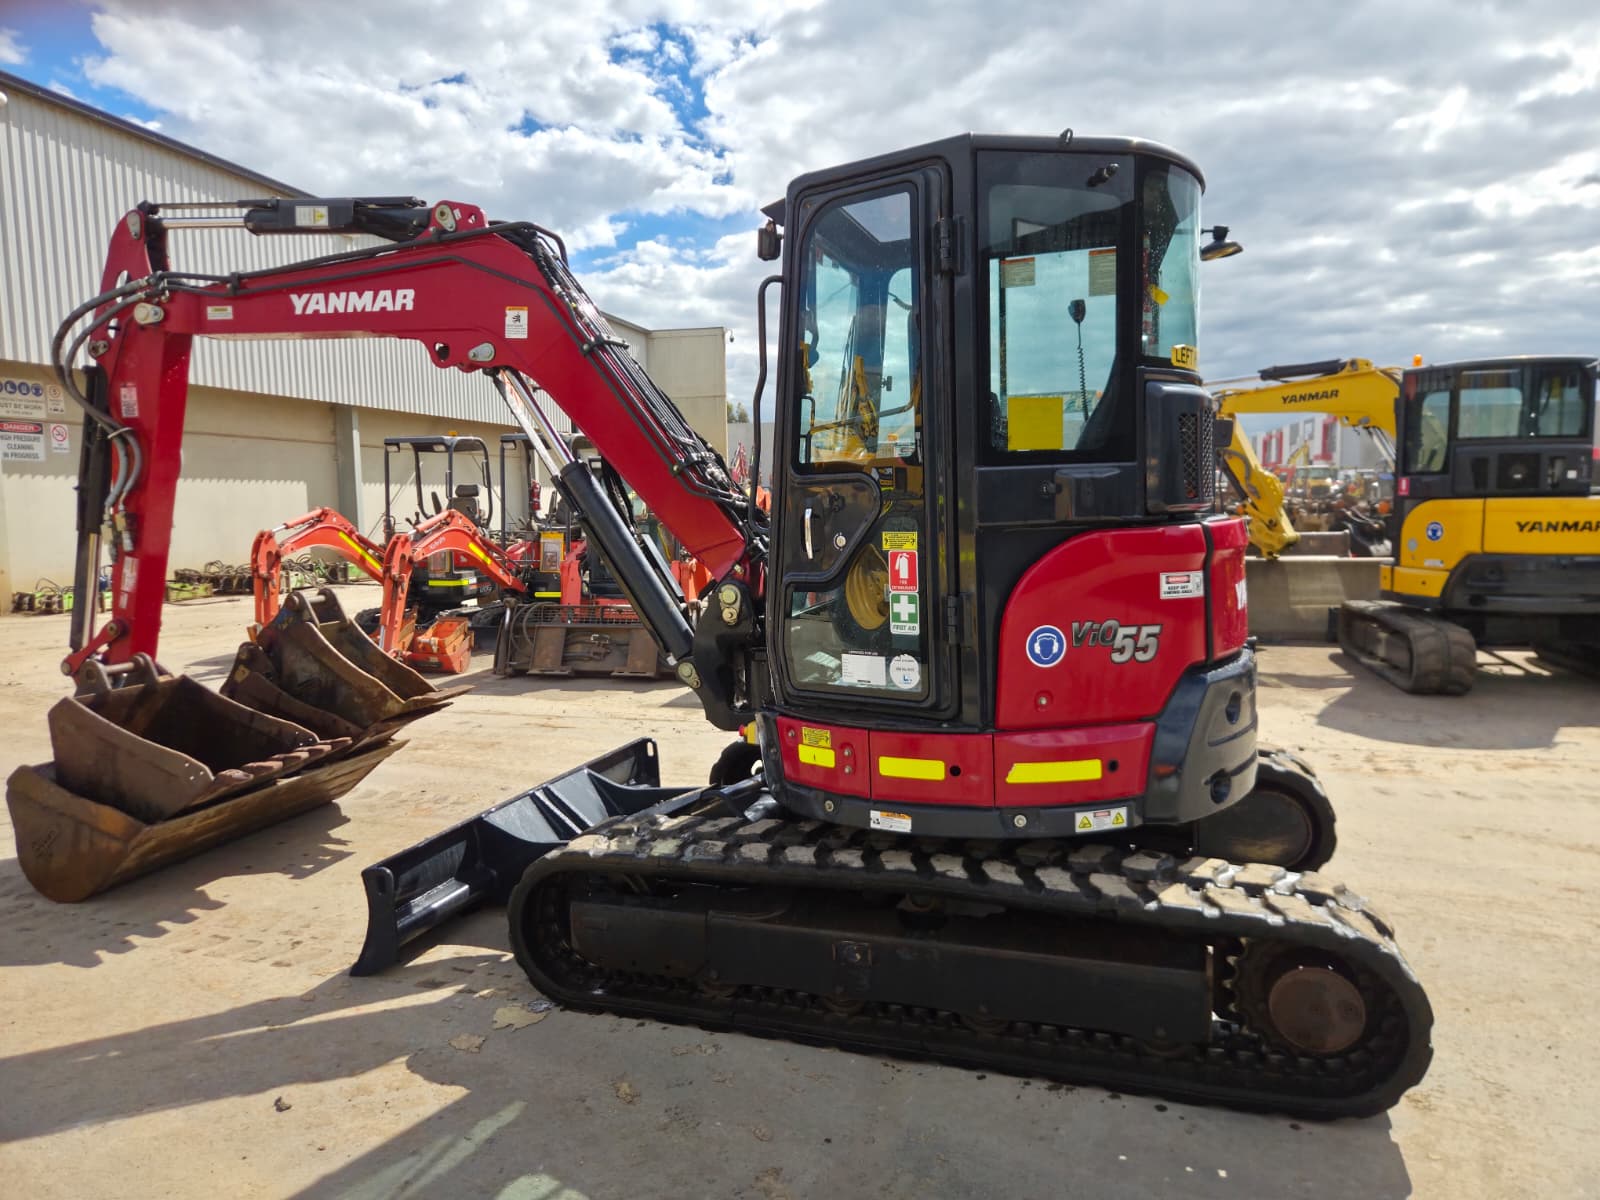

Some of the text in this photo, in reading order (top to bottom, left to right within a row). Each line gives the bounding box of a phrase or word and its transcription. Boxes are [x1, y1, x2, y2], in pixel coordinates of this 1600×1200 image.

[289, 289, 415, 315] YANMAR
[1282, 389, 1339, 404] YANMAR
[3, 423, 34, 431] DANGER
[908, 624, 917, 632] AID
